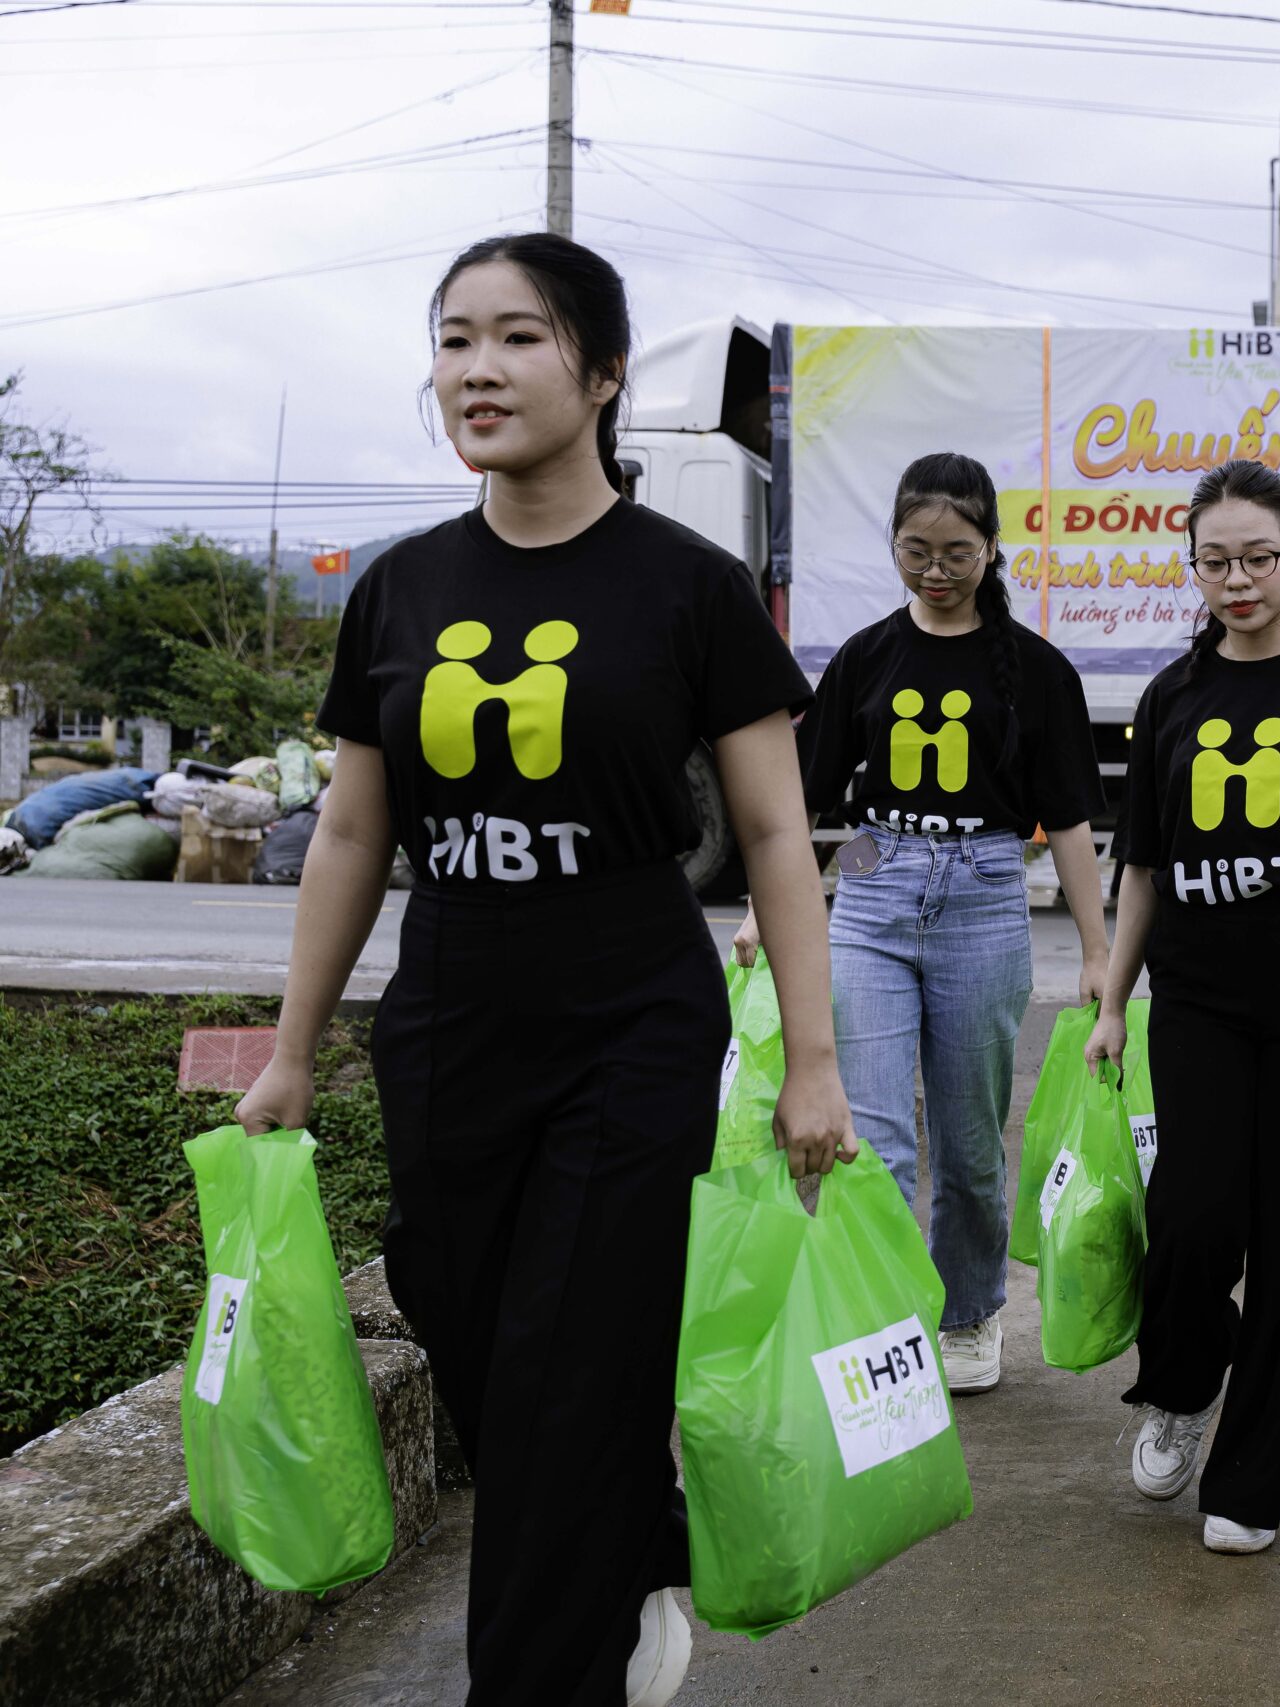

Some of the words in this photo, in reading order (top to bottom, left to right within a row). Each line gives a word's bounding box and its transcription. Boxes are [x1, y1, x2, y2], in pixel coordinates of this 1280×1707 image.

[1108, 552, 1188, 589] trình
[1125, 597, 1152, 622] về
[1153, 602, 1176, 622] bà
[424, 811, 591, 882] HiBT
[1133, 1125, 1156, 1149] iBT
